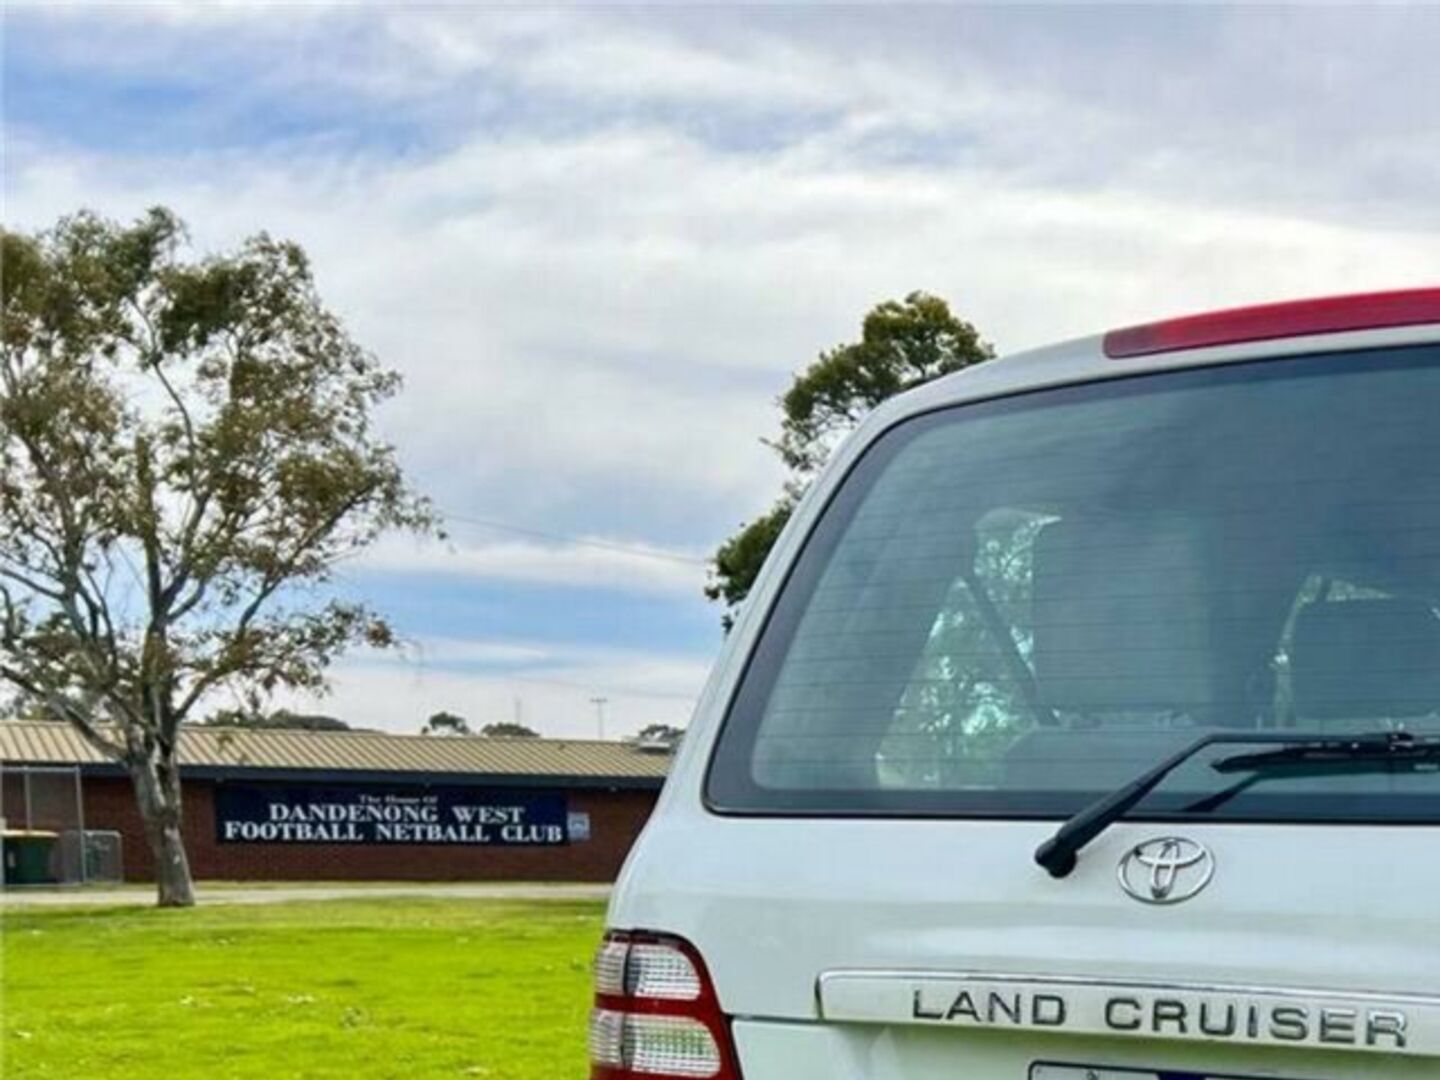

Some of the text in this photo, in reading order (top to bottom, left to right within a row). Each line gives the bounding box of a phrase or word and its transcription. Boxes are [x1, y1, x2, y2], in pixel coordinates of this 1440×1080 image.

[269, 803, 526, 824] DANDENONG WEST
[224, 821, 563, 843] FOOTBALL NETBALL CLUB
[913, 990, 1408, 1048] LAND CRUISER
